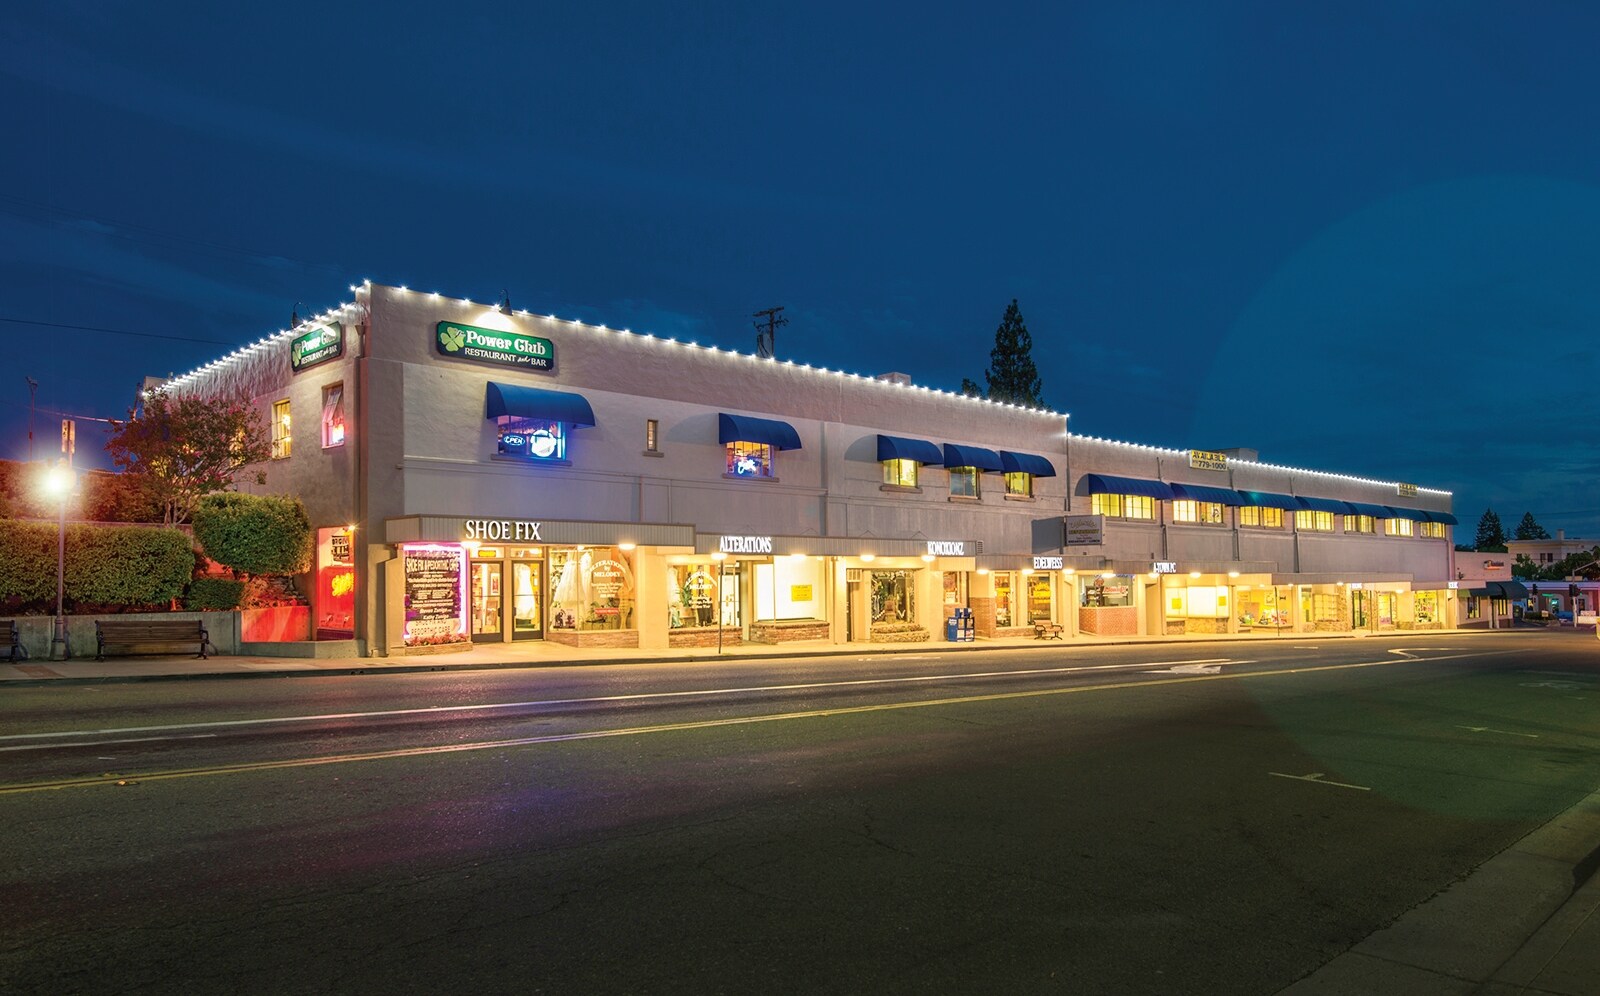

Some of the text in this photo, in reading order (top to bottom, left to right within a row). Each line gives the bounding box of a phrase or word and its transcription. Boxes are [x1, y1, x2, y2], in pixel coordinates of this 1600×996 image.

[466, 330, 546, 355] Power Club
[464, 347, 517, 362] RESTAURANT
[531, 358, 547, 367] BAR
[1198, 460, 1227, 470] 779-1000
[465, 519, 541, 540] SHOE FIX
[720, 535, 772, 553] ALTERATIONS
[1033, 556, 1063, 570] EDELWEISS
